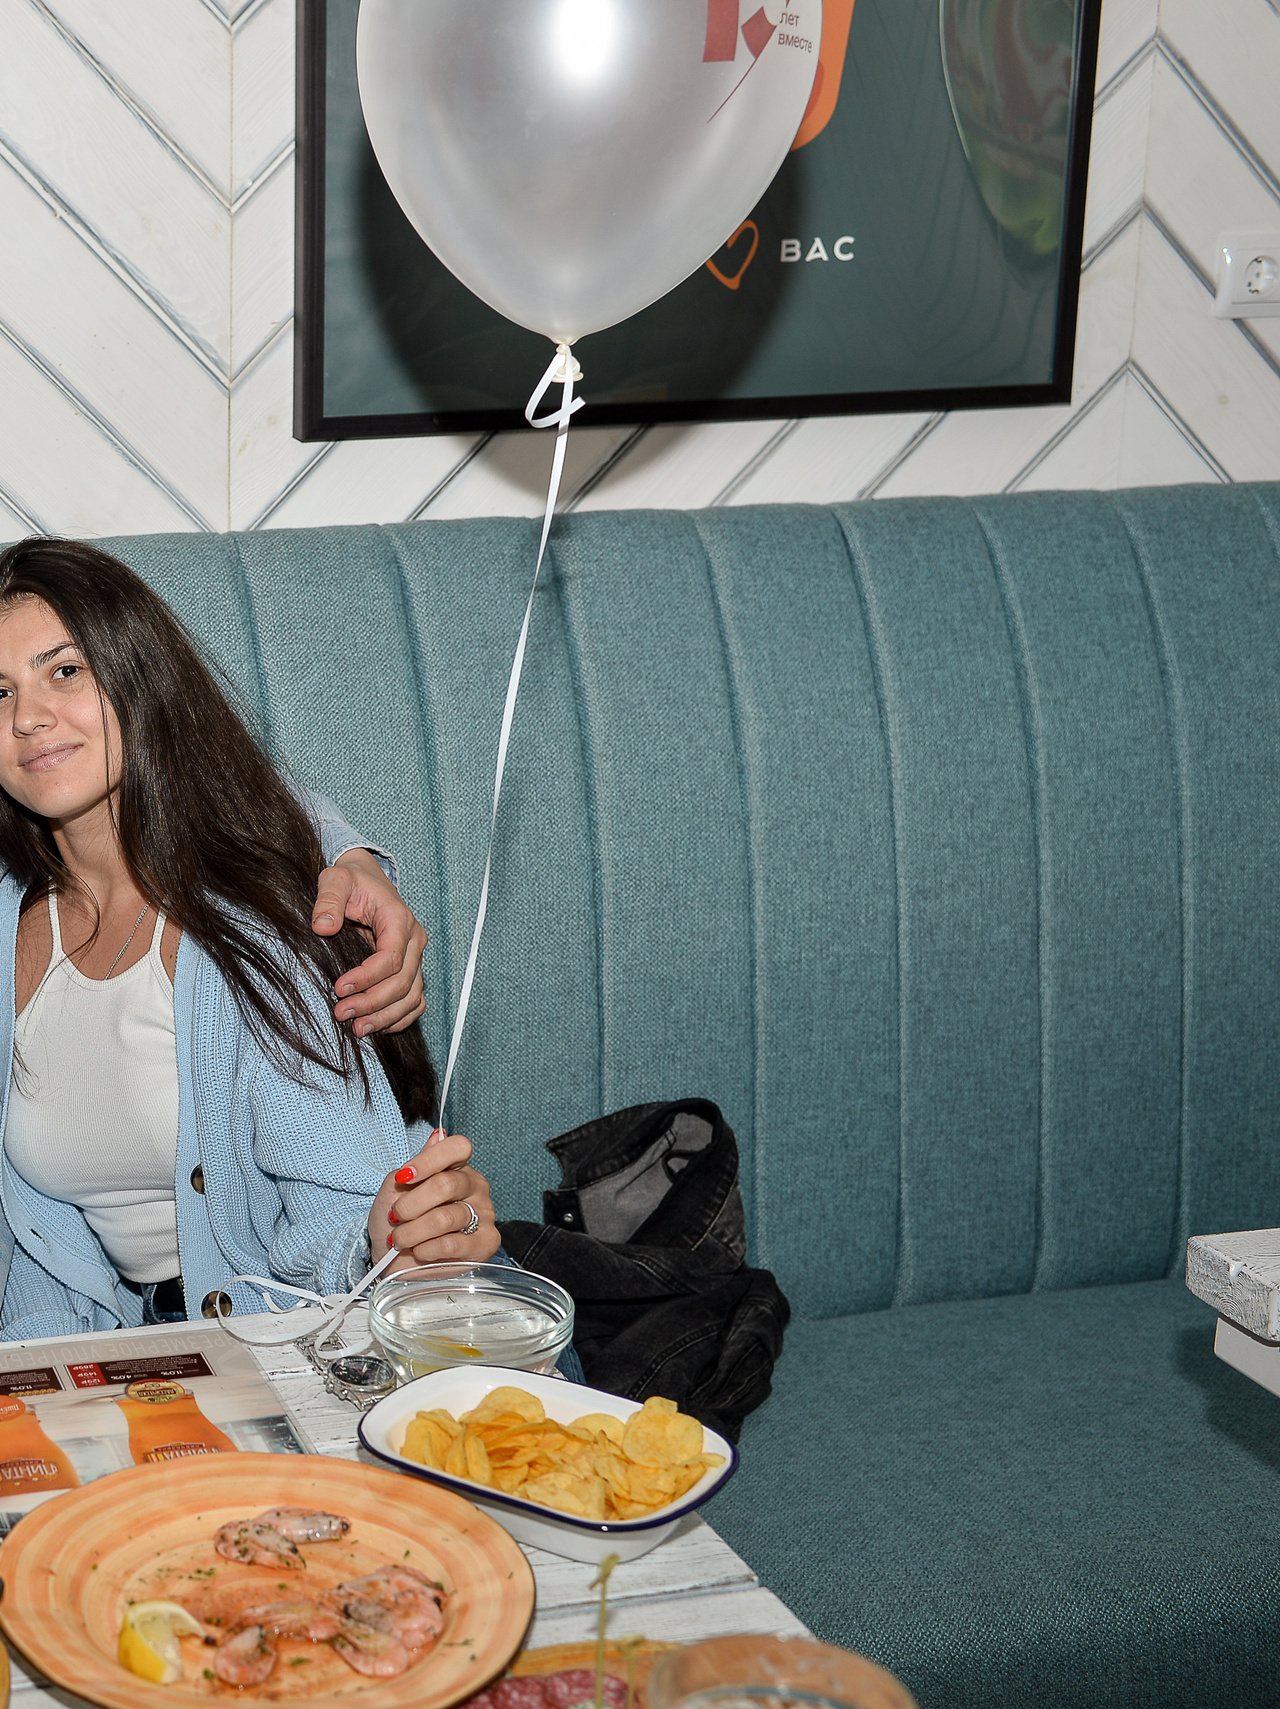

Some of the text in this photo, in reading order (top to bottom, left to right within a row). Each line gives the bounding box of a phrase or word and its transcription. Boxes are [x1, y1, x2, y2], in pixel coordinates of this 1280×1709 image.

[779, 12, 800, 27] лет
[778, 33, 813, 54] вместе
[780, 235, 856, 263] ВАС
[0, 1463, 58, 1481] ПИНТА
